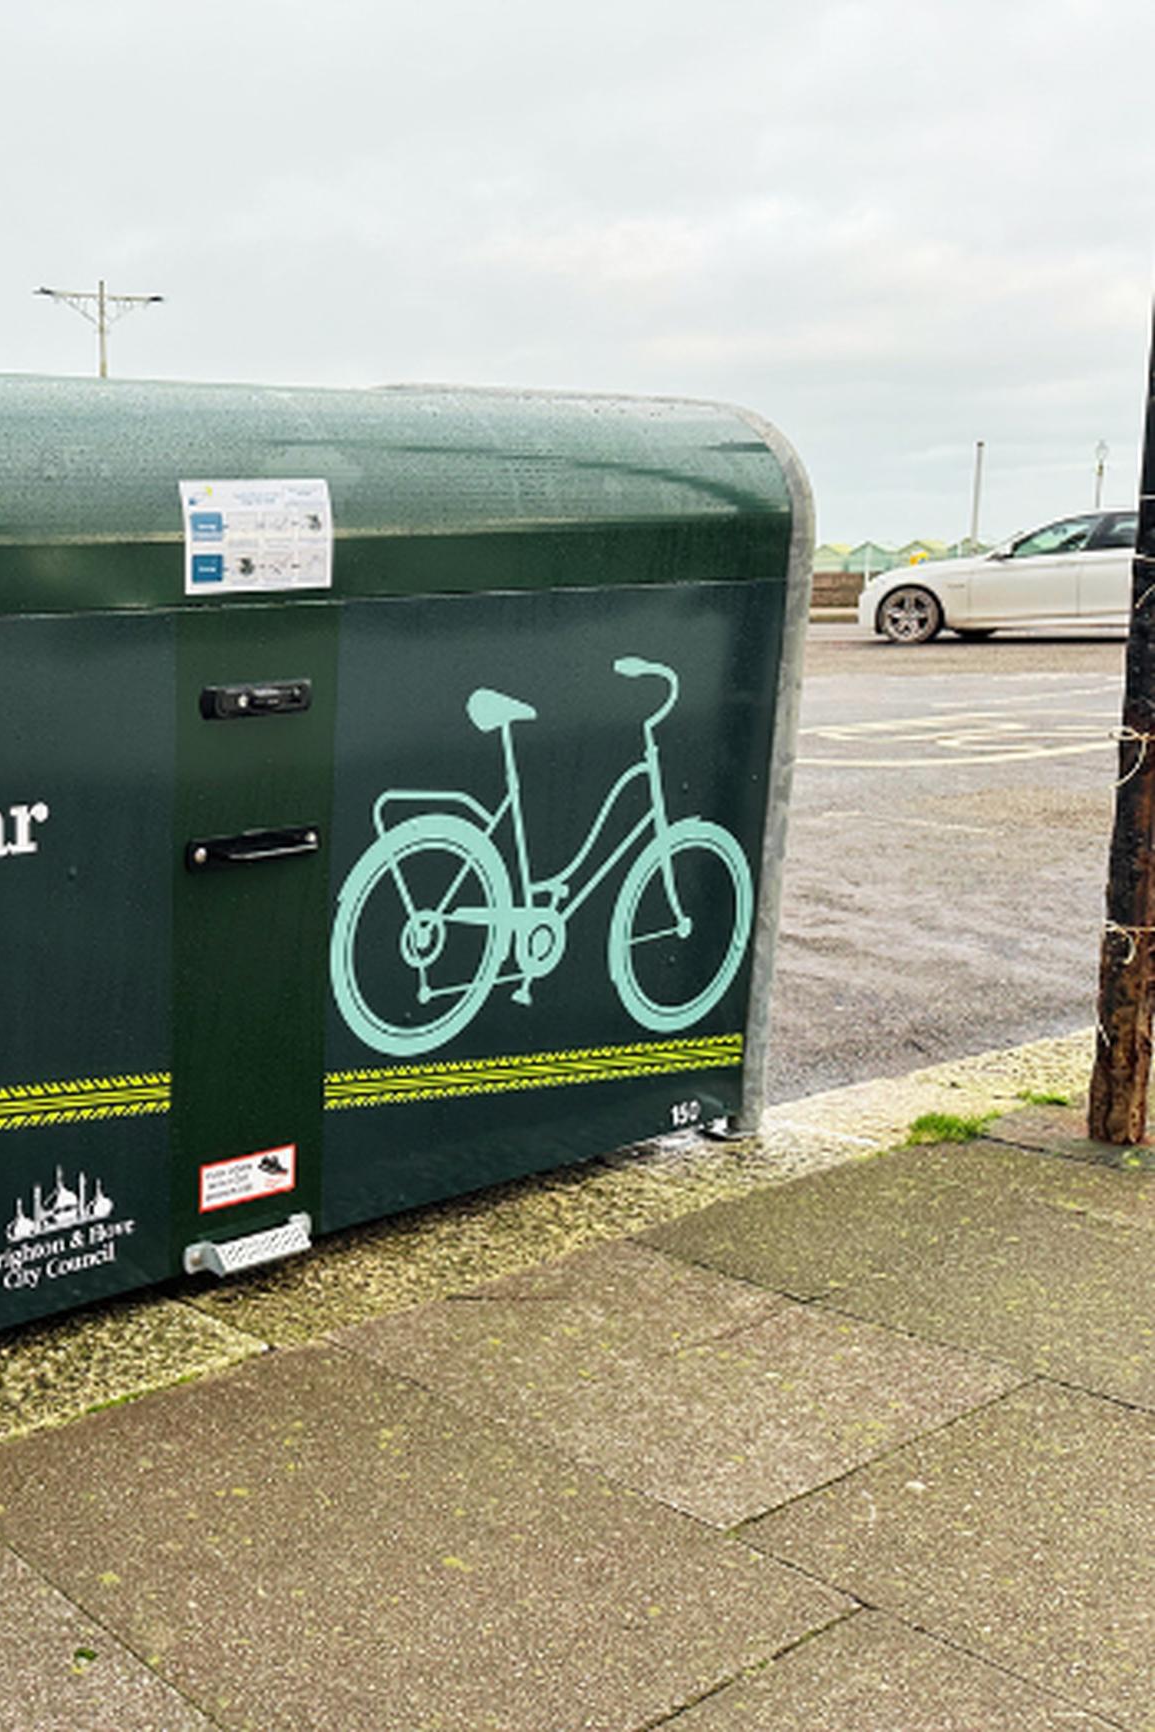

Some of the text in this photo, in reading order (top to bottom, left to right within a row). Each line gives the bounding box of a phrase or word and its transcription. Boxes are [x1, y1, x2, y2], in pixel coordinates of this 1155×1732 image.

[69, 1229, 86, 1250] &
[89, 1219, 136, 1246] Hove
[2, 1241, 116, 1290] City Council
